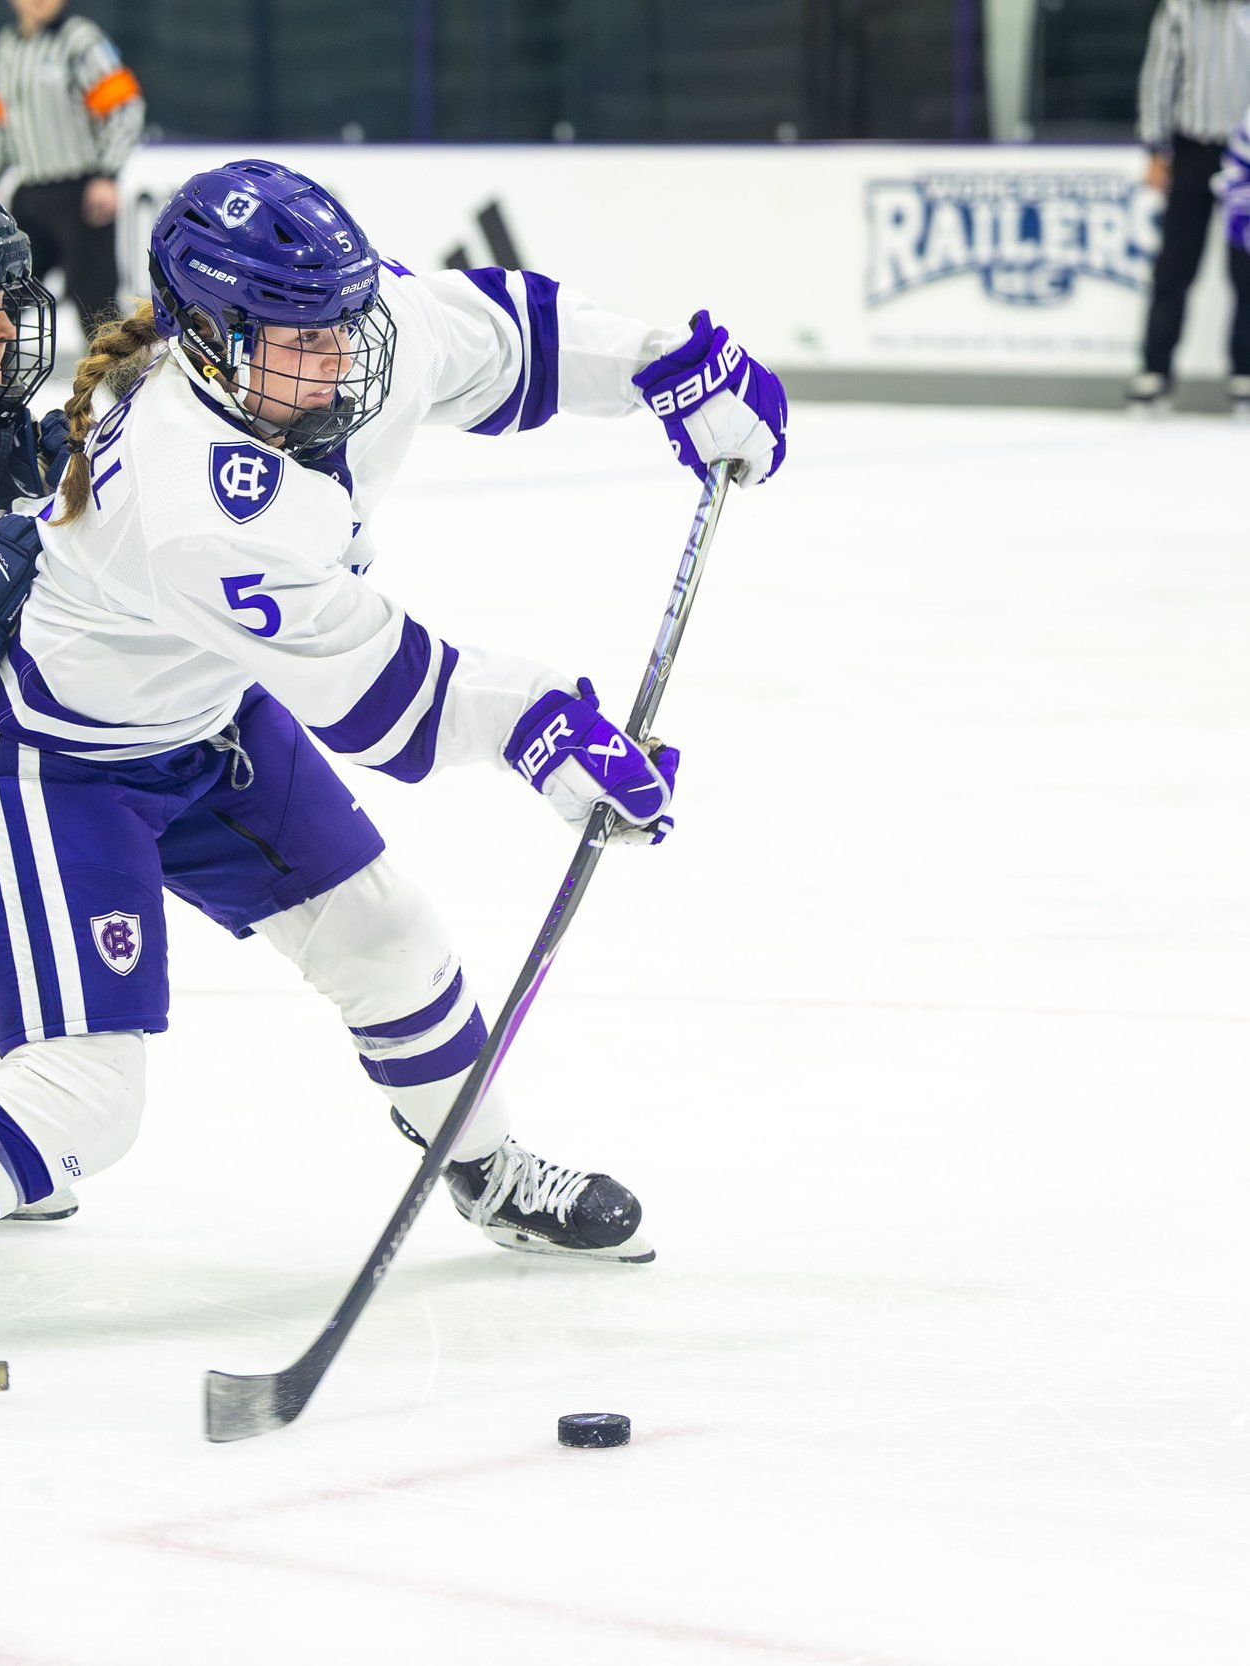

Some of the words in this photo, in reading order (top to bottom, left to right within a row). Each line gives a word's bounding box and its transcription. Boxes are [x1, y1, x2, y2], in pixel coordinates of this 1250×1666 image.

[332, 230, 353, 253] 5
[866, 180, 1164, 306] RAILERS
[188, 258, 238, 286] BAUER
[341, 275, 376, 296] BAUER
[187, 328, 221, 363] BAUER
[220, 573, 282, 638] 5
